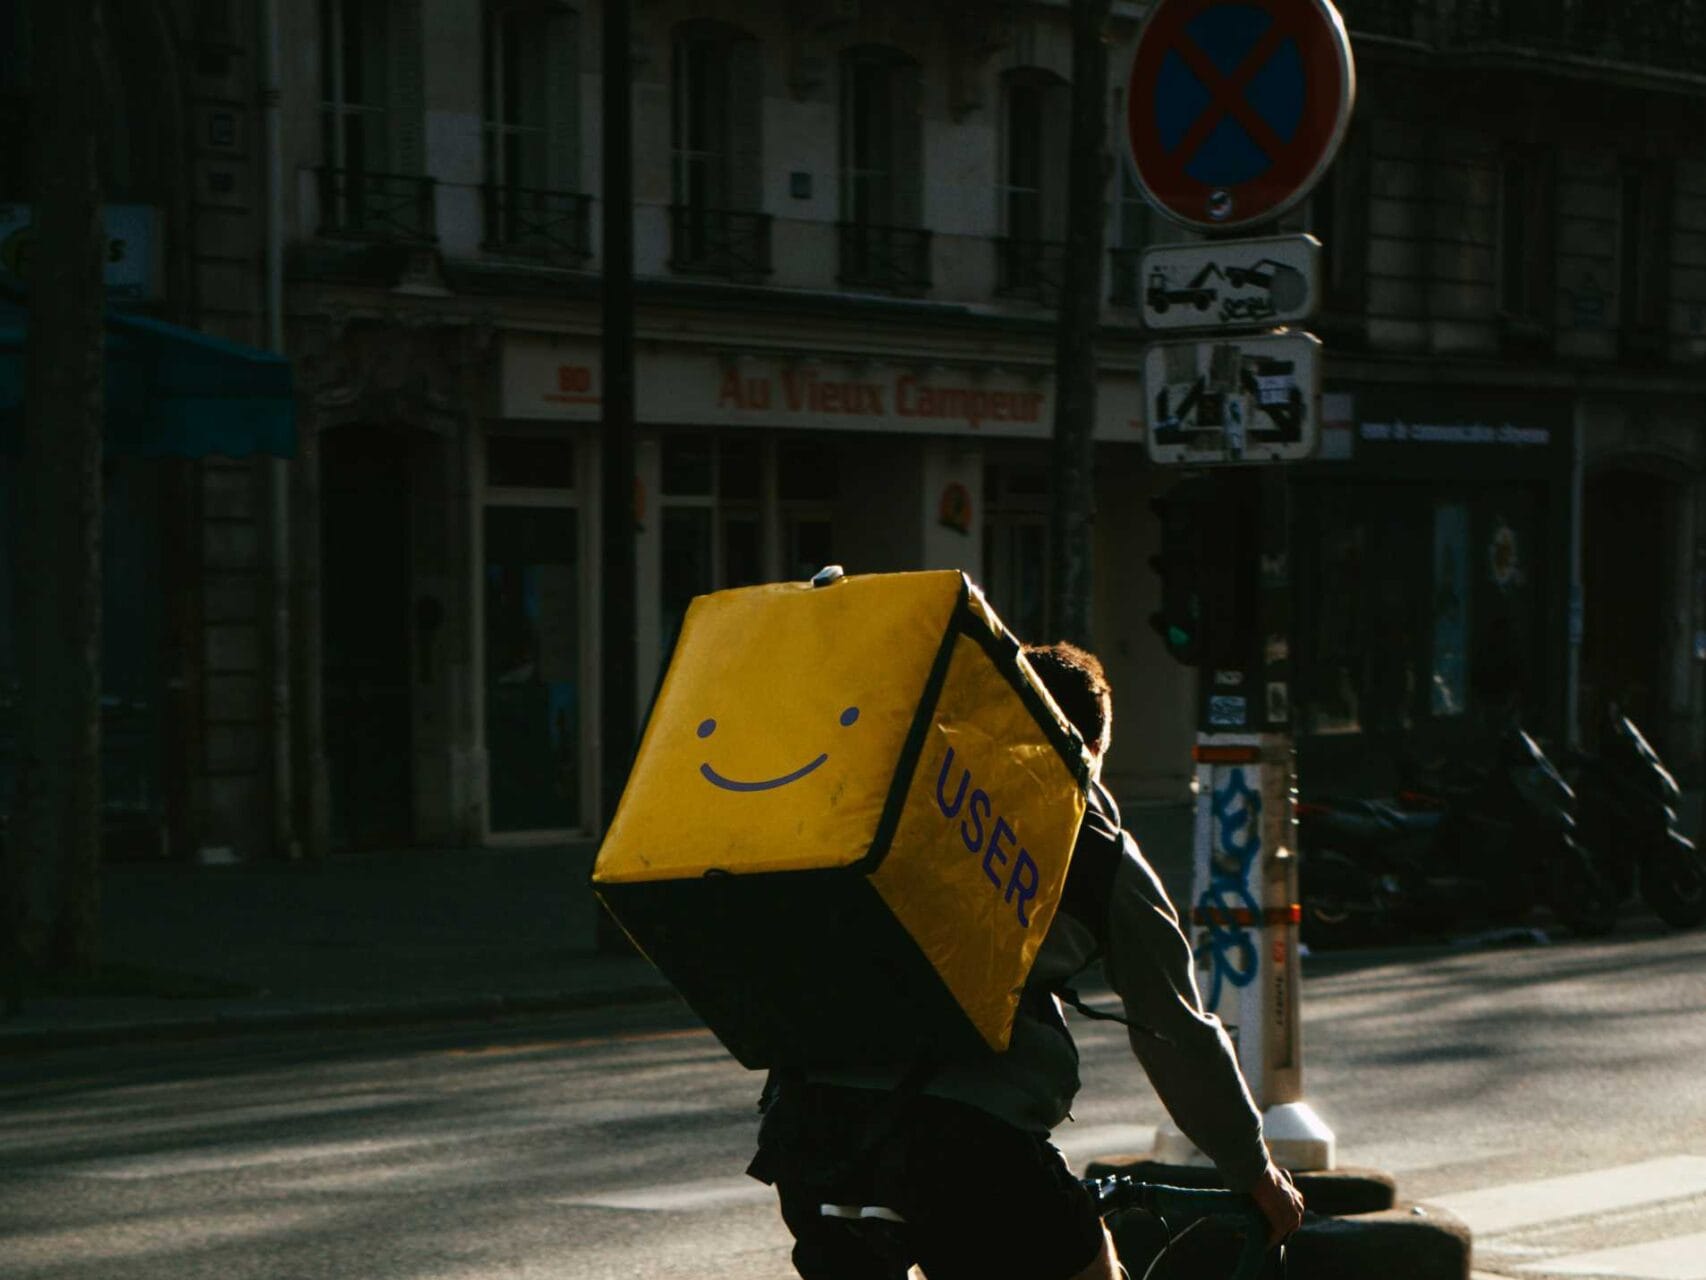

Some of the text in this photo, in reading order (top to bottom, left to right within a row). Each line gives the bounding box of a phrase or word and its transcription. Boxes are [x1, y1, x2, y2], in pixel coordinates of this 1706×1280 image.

[718, 368, 1045, 429] Au Vieux Campeur
[936, 747, 1040, 928] USER
